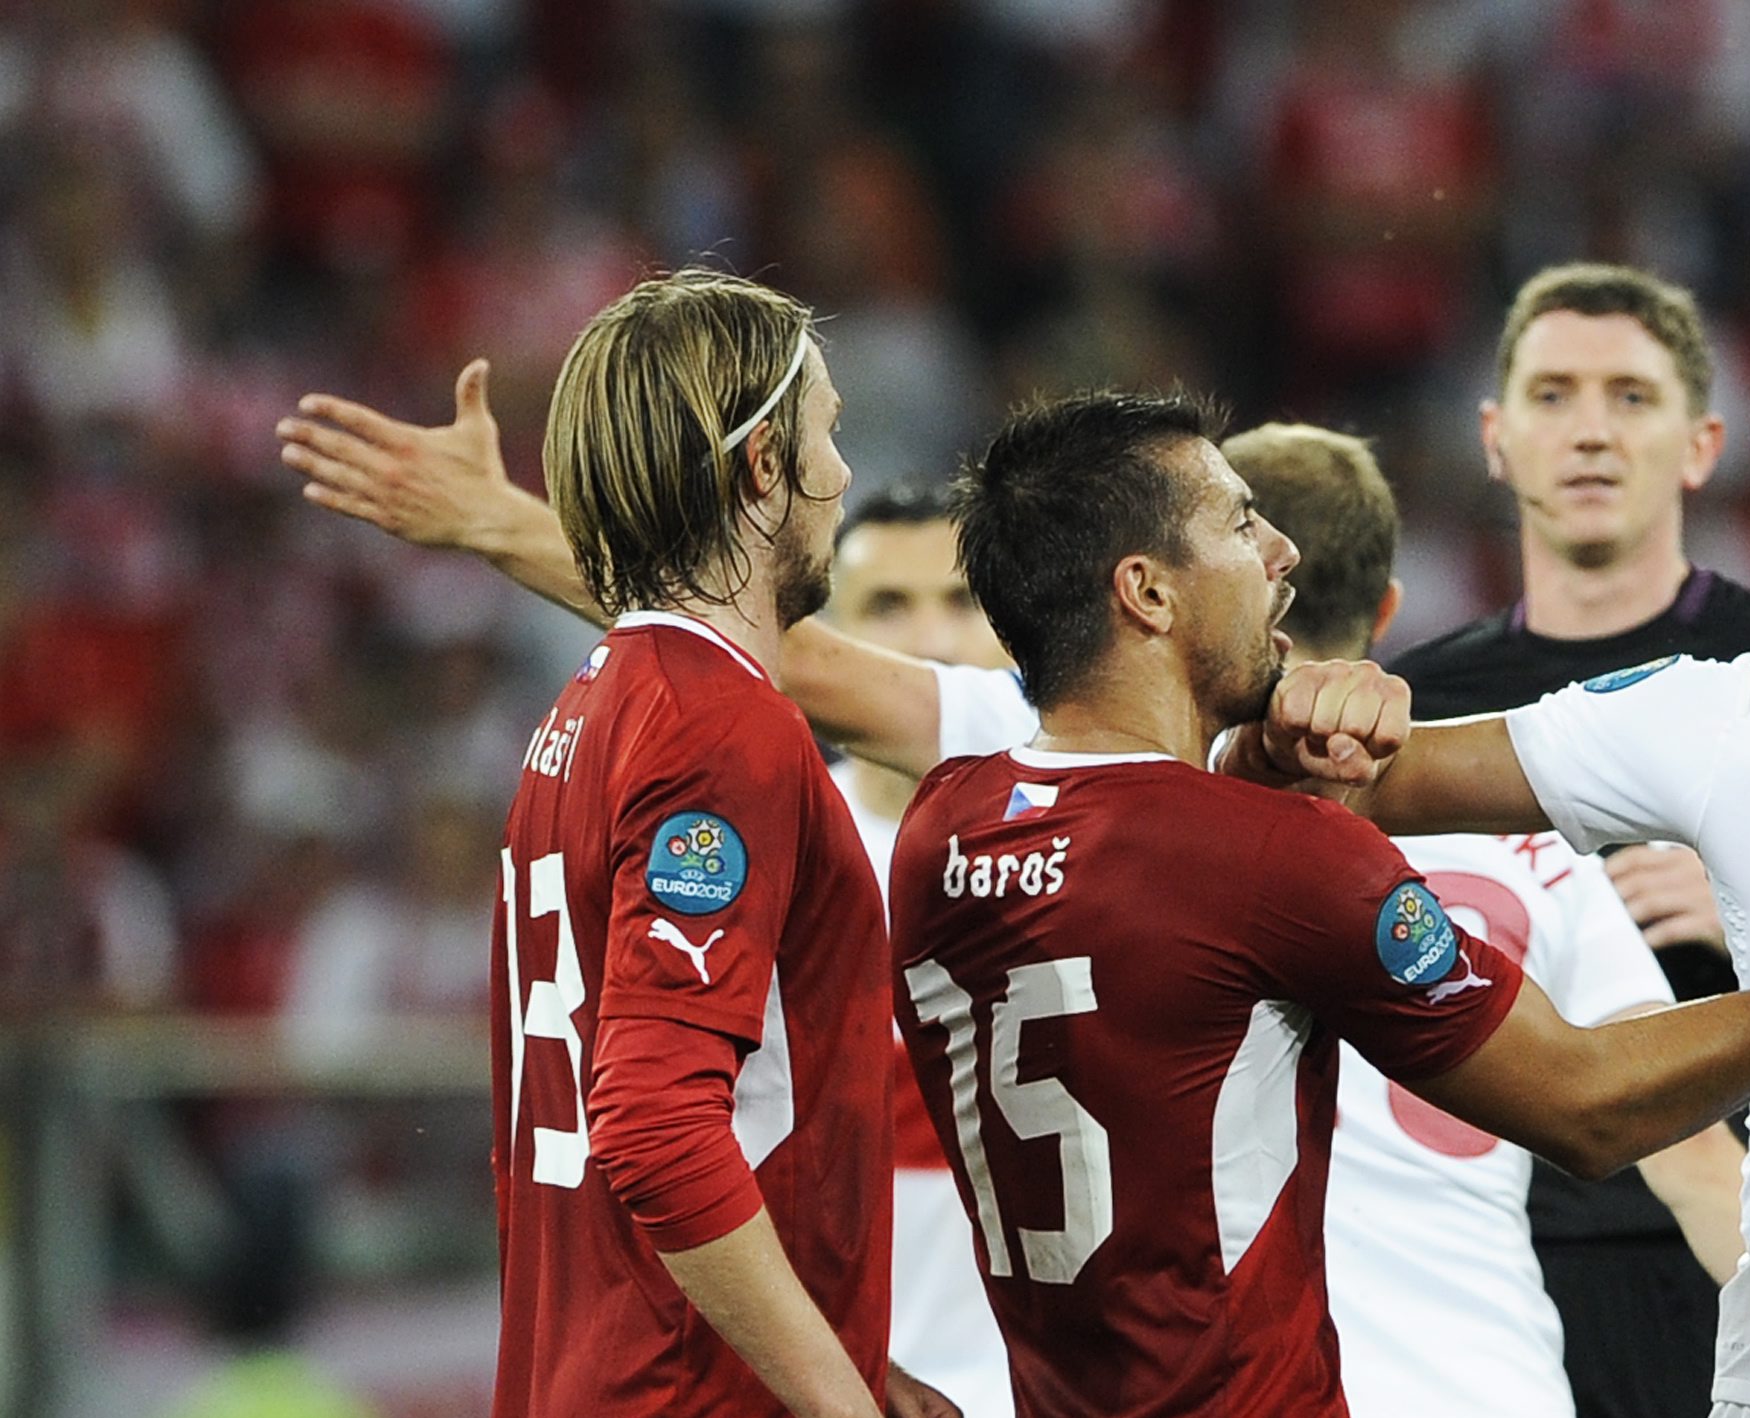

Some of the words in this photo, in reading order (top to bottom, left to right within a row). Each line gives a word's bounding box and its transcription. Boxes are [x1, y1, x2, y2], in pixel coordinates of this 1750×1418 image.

[651, 877, 732, 902] EURO2012
[943, 834, 1069, 899] baroš
[501, 846, 590, 1189] 13
[903, 955, 1114, 1285] 15
